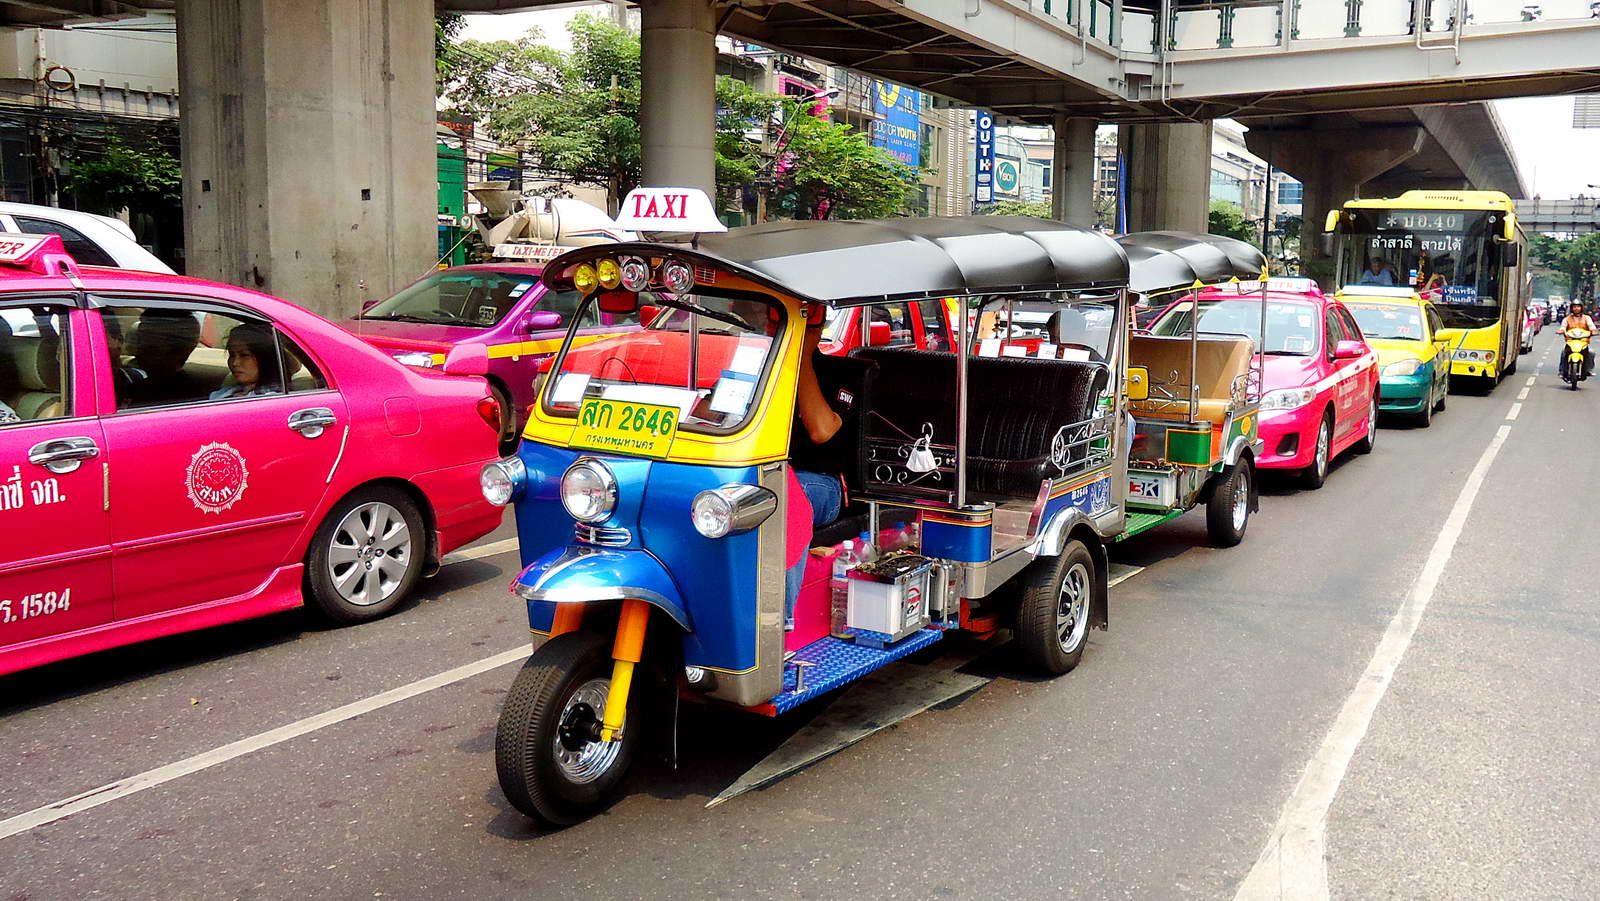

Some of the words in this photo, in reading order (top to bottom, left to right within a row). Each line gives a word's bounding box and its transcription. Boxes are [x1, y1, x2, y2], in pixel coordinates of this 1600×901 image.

[896, 126, 917, 141] YOUTH
[980, 112, 993, 171] OUTH
[631, 194, 689, 219] TAXI
[0, 241, 25, 255] ER
[582, 401, 613, 429] สก
[618, 405, 674, 435] 2646
[30, 477, 67, 505] จก.
